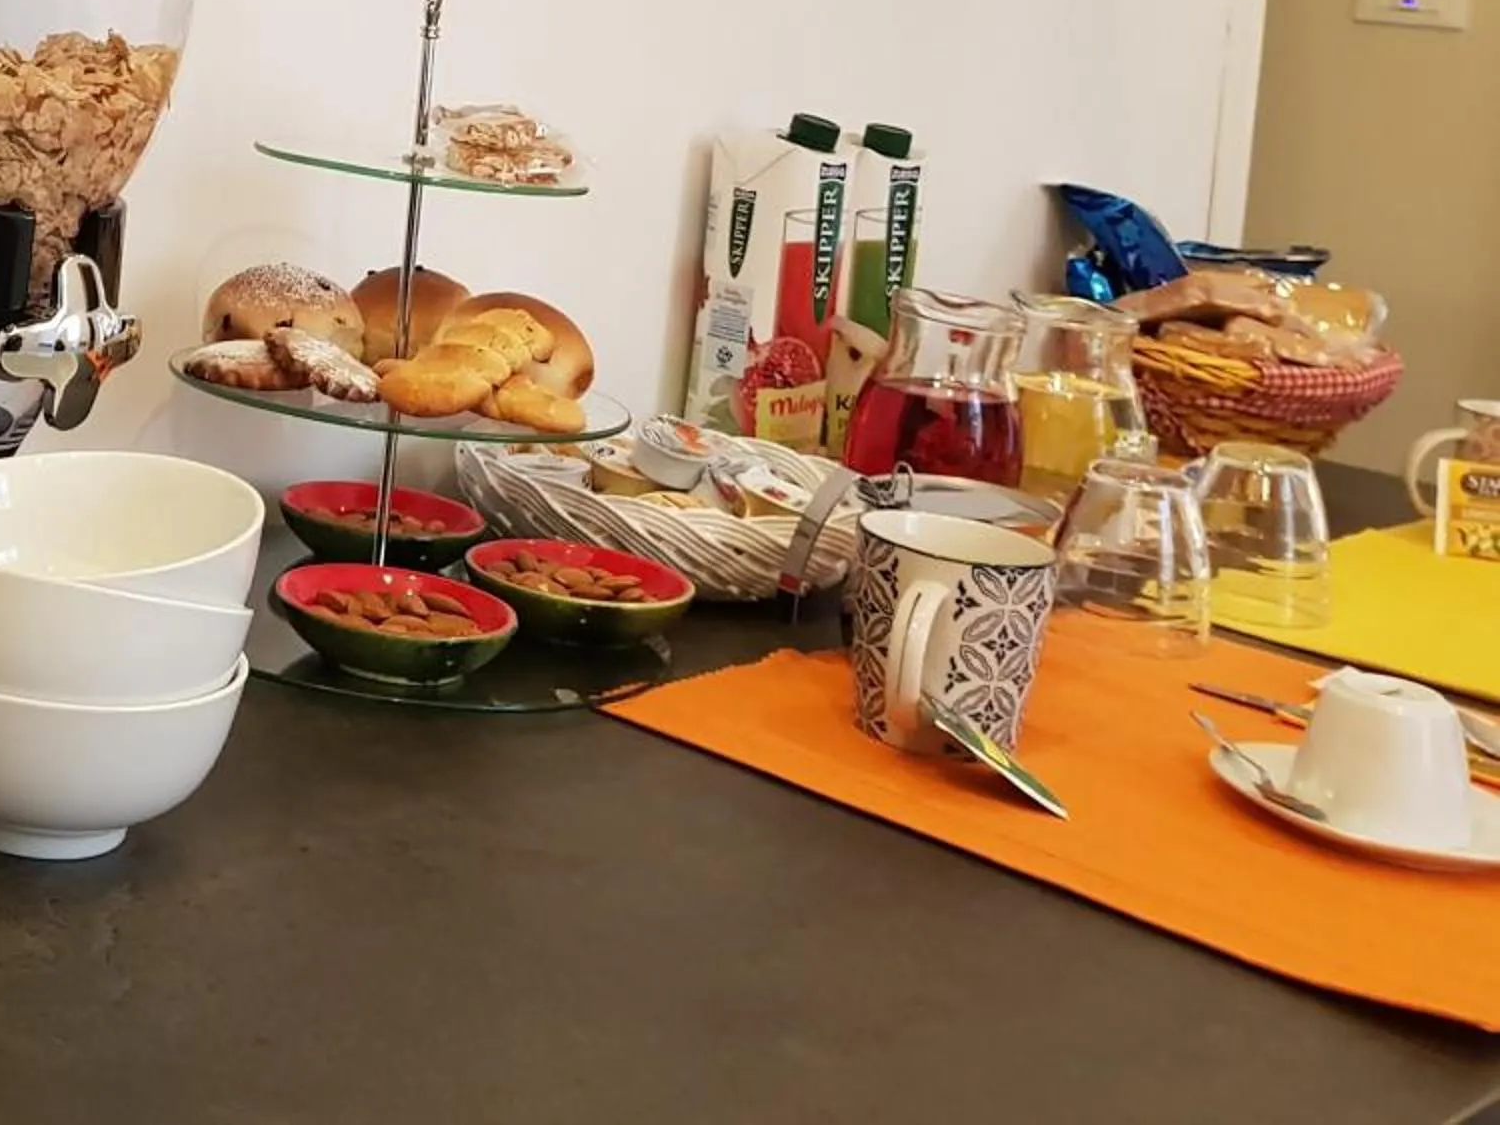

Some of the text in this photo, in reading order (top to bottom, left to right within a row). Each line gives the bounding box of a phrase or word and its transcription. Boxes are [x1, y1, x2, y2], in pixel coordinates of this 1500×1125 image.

[731, 202, 752, 265] SKIPPER
[814, 187, 839, 301] SKIPPER
[885, 188, 911, 297] SKIPPER
